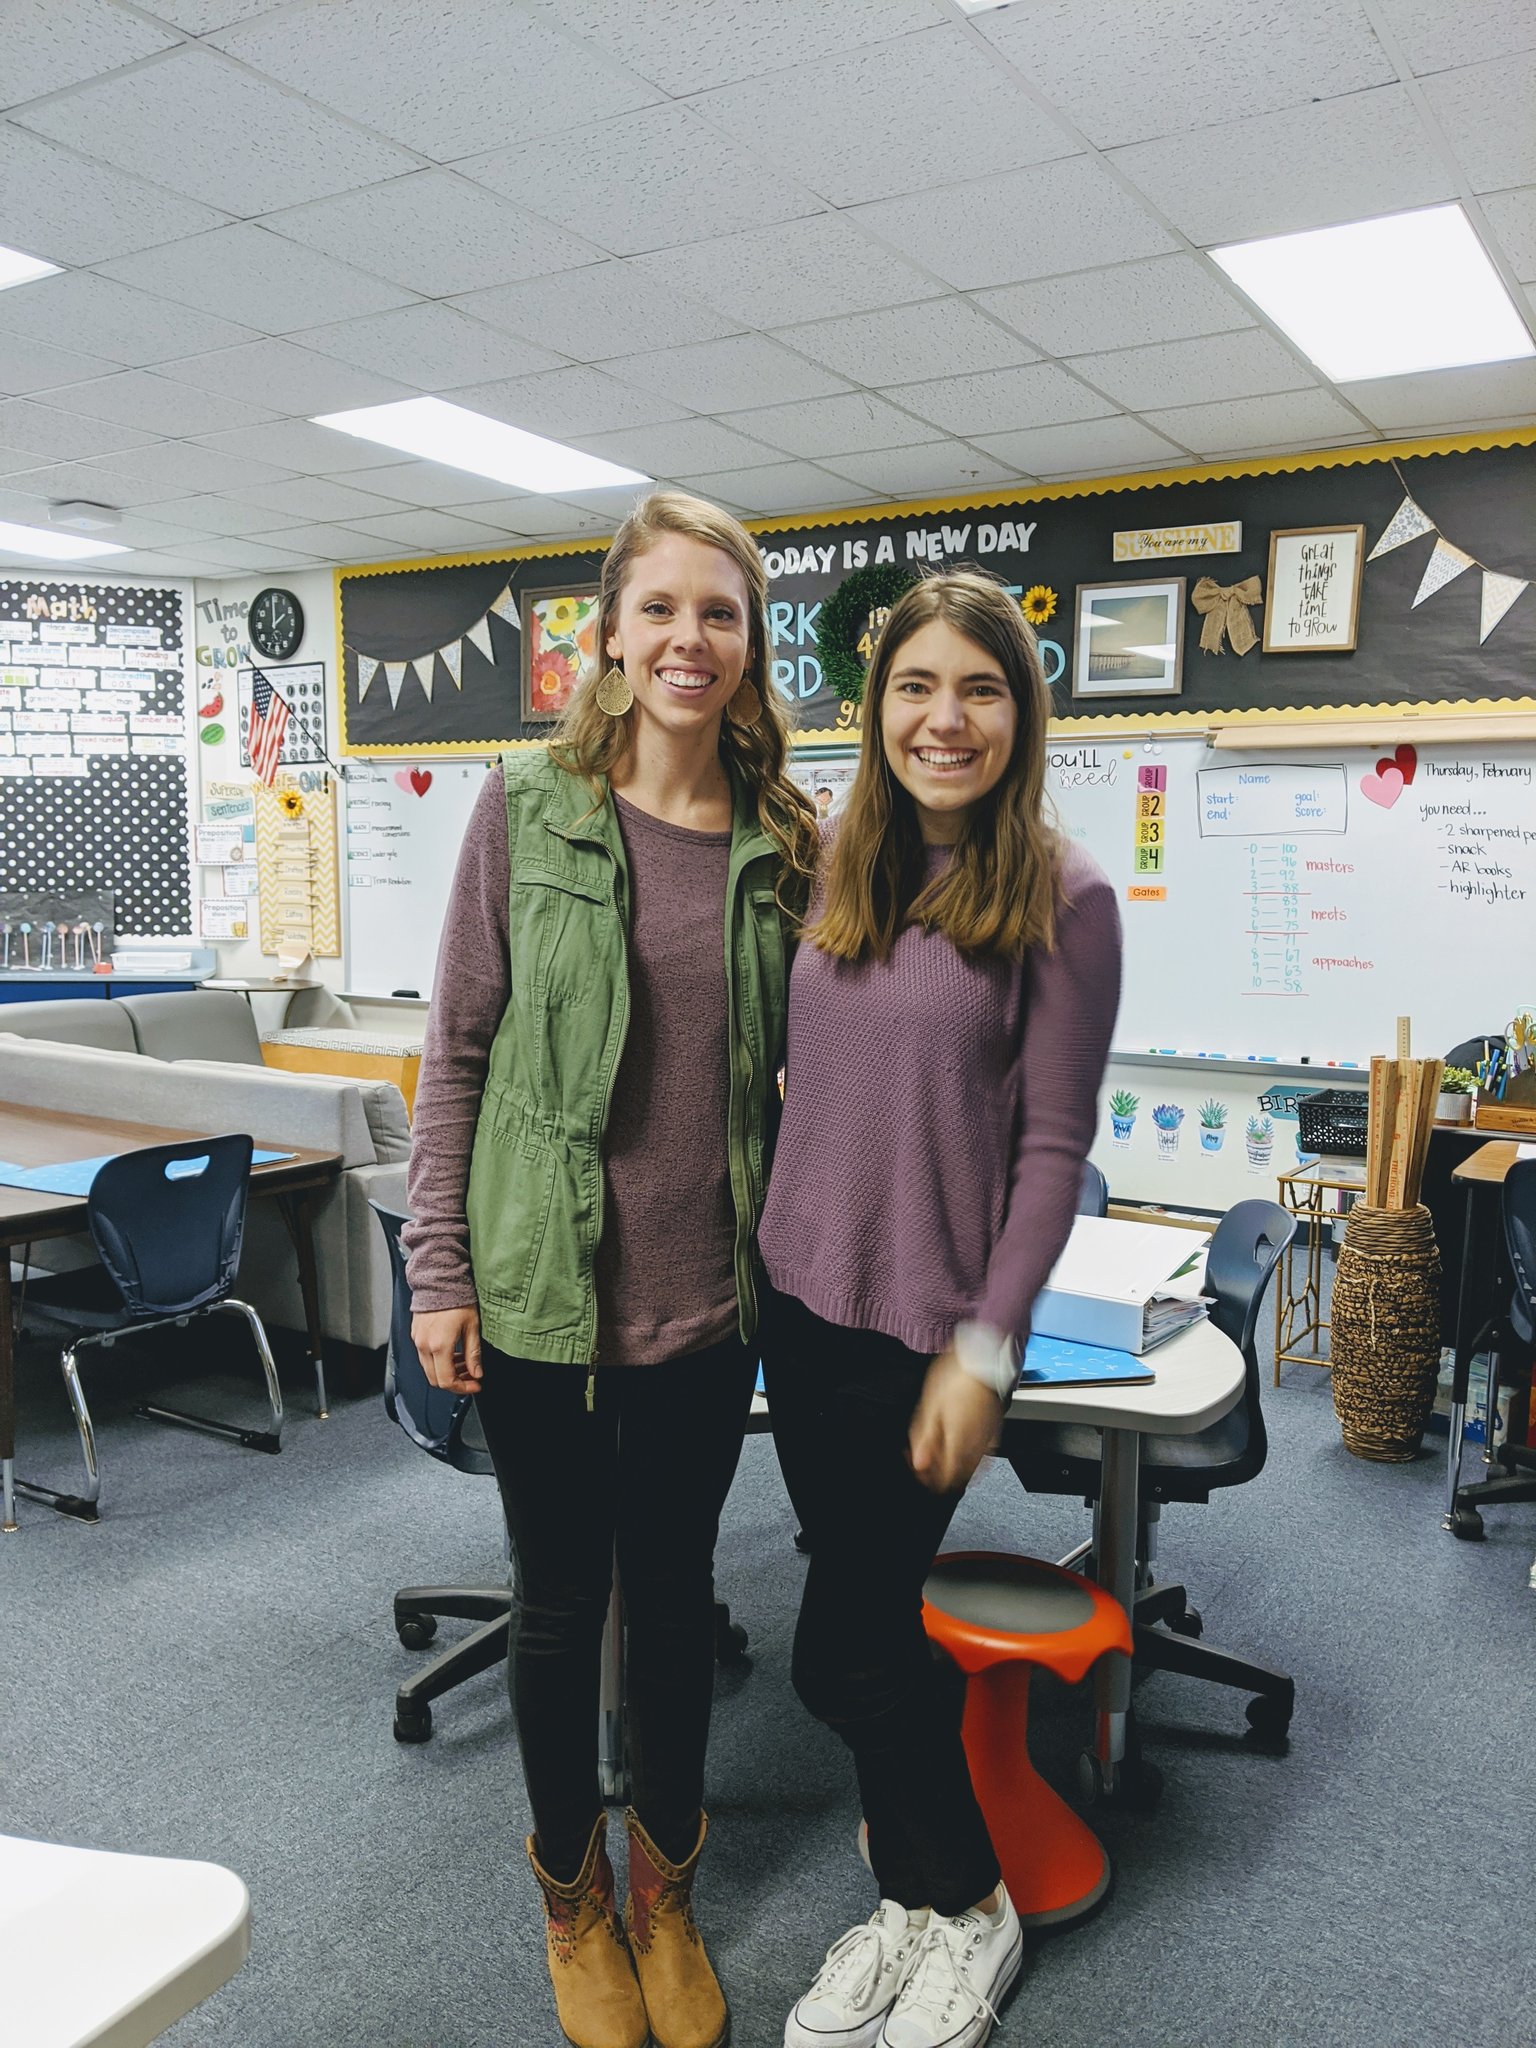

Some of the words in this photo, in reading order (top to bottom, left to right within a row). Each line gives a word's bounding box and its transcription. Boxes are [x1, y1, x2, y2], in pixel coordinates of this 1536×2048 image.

[1114, 525, 1236, 558] SUNSHINE
[1138, 533, 1162, 549] You
[1164, 538, 1184, 546] are
[1187, 536, 1208, 548] my
[760, 545, 836, 579] ODAY
[843, 540, 868, 569] IS
[875, 535, 895, 564] A
[906, 523, 971, 562] NEW
[977, 522, 1037, 553] DAY
[26, 595, 98, 623] Math
[764, 601, 823, 646] RK
[1288, 616, 1300, 638] to
[220, 624, 238, 643] to
[195, 642, 252, 669] GROW
[770, 655, 823, 702] RD
[1060, 758, 1118, 788] need
[1239, 773, 1271, 785] Name
[1424, 761, 1479, 782] Thursday,
[1482, 762, 1532, 785] February
[1141, 795, 1150, 817] GROUP
[1150, 795, 1160, 816] 2
[1420, 803, 1440, 822] you
[1140, 822, 1149, 844] GROUP
[1149, 822, 1159, 842] 3
[1445, 823, 1455, 836] 2
[1459, 822, 1520, 841] sharpened
[1281, 843, 1298, 854] 100
[1447, 842, 1487, 855] snack
[1140, 848, 1149, 869] GROUP
[1149, 848, 1159, 869] 4
[1281, 856, 1297, 867] 96
[1305, 857, 1355, 874] masters
[1279, 869, 1295, 880] 92
[1451, 860, 1471, 873] AR
[1474, 861, 1513, 878] books
[1133, 888, 1160, 897] Gates
[1282, 882, 1299, 893] 88
[1450, 879, 1527, 905] highlighter
[1282, 895, 1298, 906] 83
[1284, 907, 1298, 918] 79
[1311, 906, 1347, 921] meets
[1285, 920, 1299, 931] 75
[1283, 932, 1296, 945] 71
[1285, 948, 1300, 962] 67
[1312, 955, 1375, 971] approaches
[1284, 964, 1302, 977] 63
[1283, 978, 1303, 993] 58
[1257, 1093, 1311, 1114] BIR
